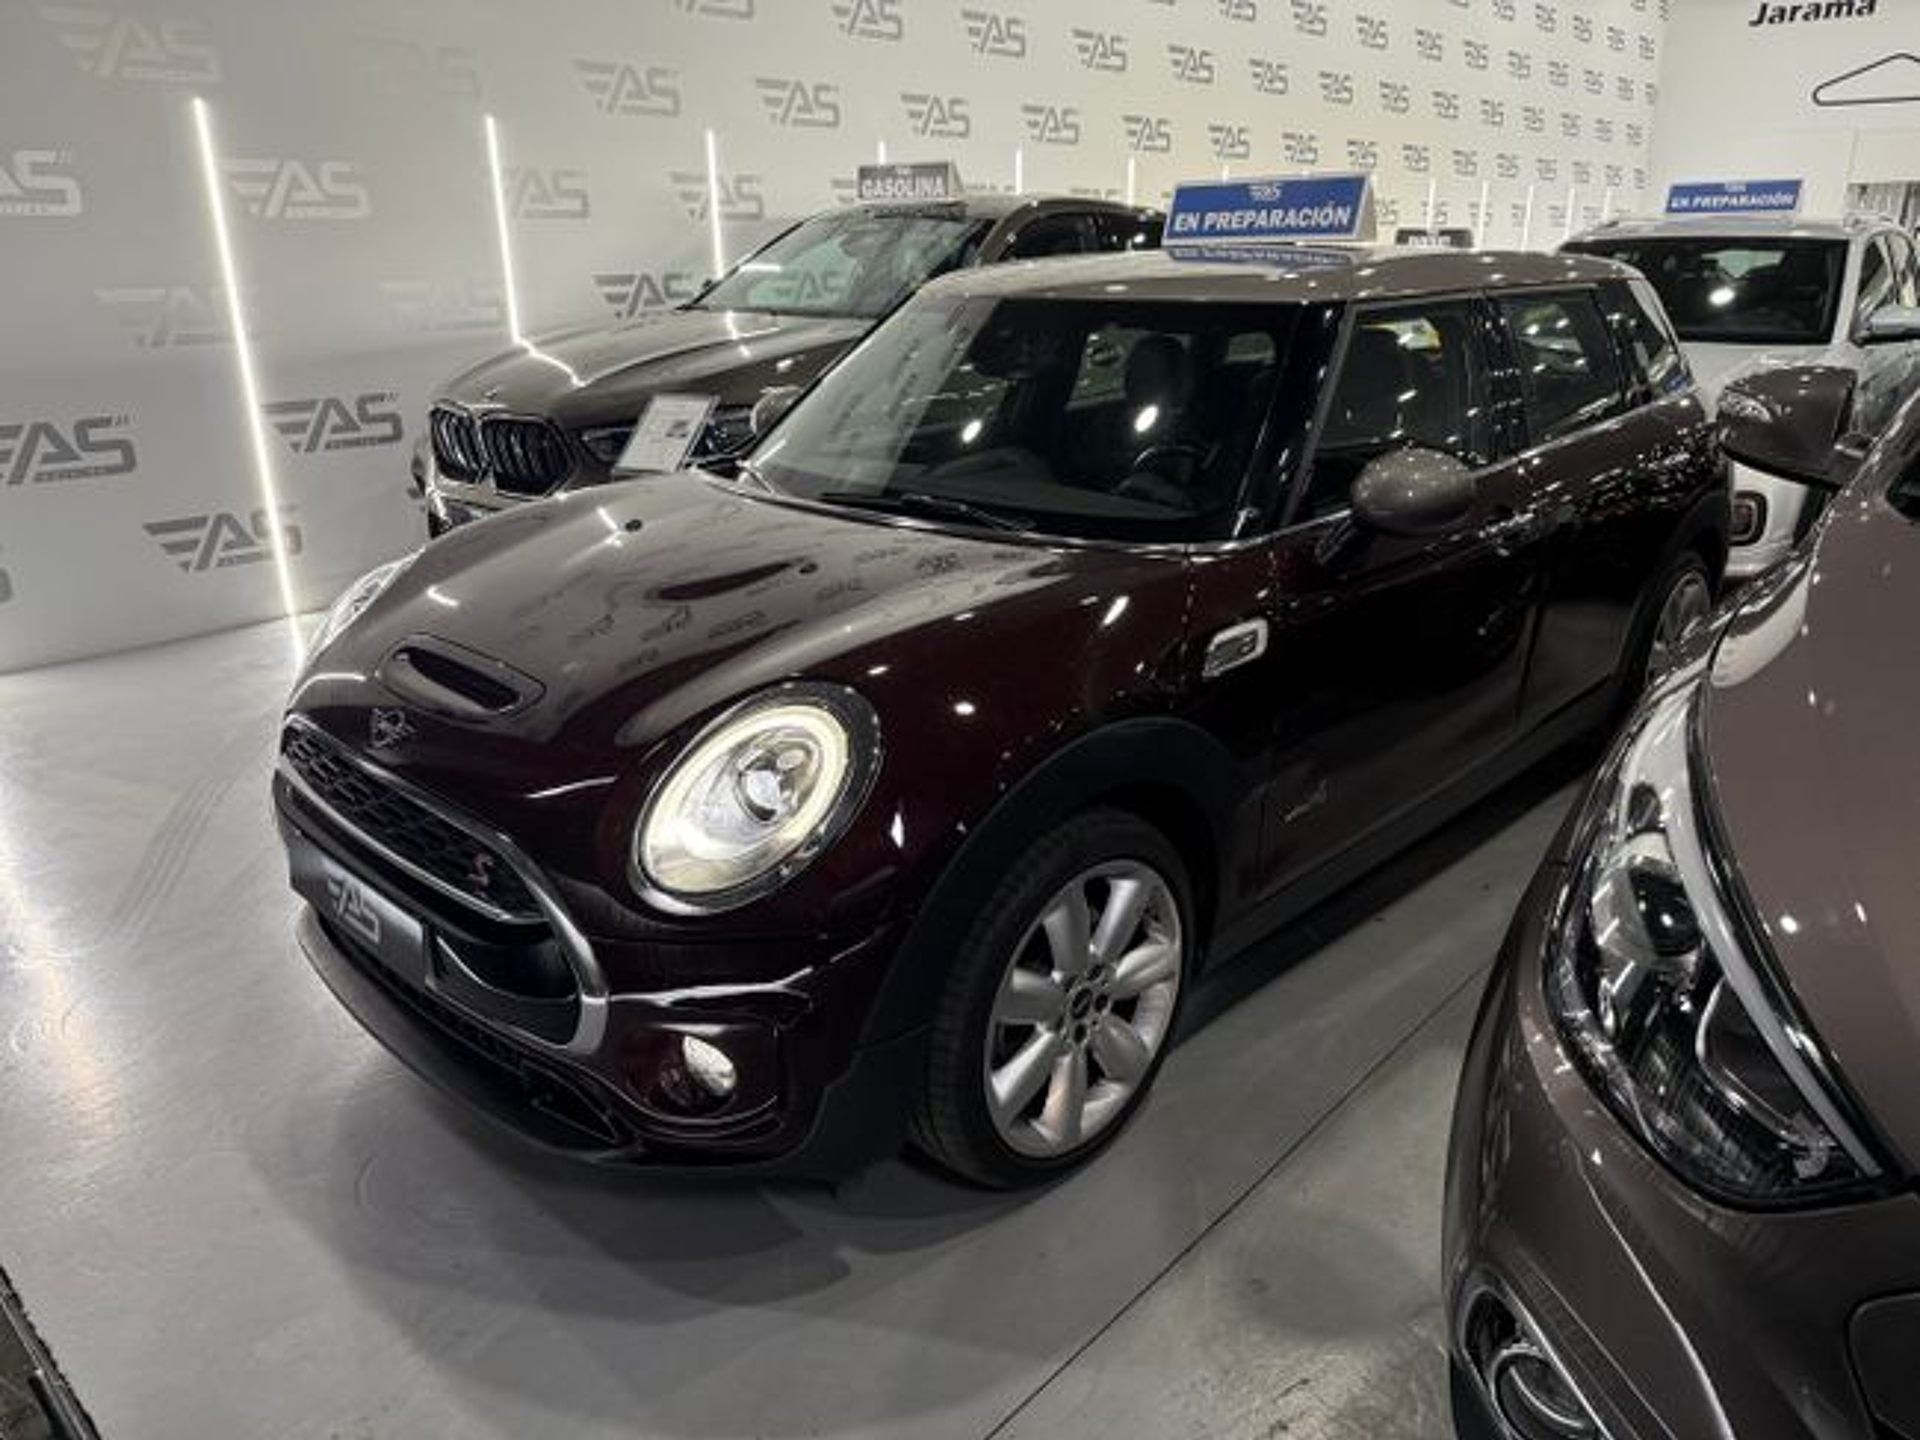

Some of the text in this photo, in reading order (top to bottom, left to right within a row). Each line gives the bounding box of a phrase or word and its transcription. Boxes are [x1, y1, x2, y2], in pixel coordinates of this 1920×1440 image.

[1748, 0, 1877, 27] Jarama
[861, 177, 946, 197] GASOLINA
[1174, 213, 1200, 231] EN
[1204, 200, 1350, 230] PREPARACIÓN
